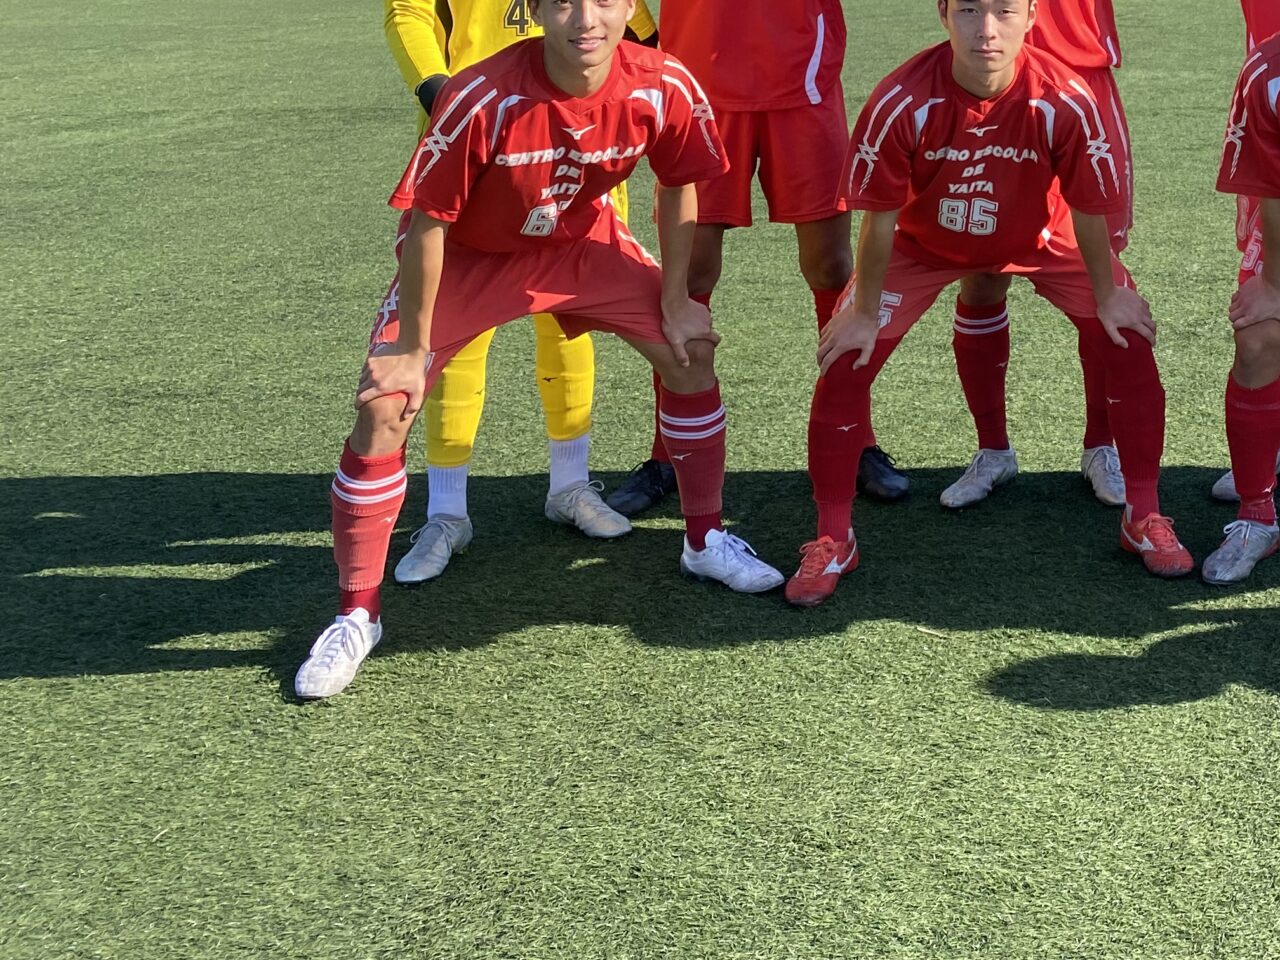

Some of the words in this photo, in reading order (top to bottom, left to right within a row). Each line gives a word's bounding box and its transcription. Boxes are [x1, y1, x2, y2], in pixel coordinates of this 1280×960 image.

[494, 147, 566, 167] CENTRO
[554, 164, 581, 178] DE
[961, 163, 986, 178] DE
[540, 183, 581, 200] YAIT
[948, 180, 994, 195] YAITA
[938, 197, 999, 236] 85
